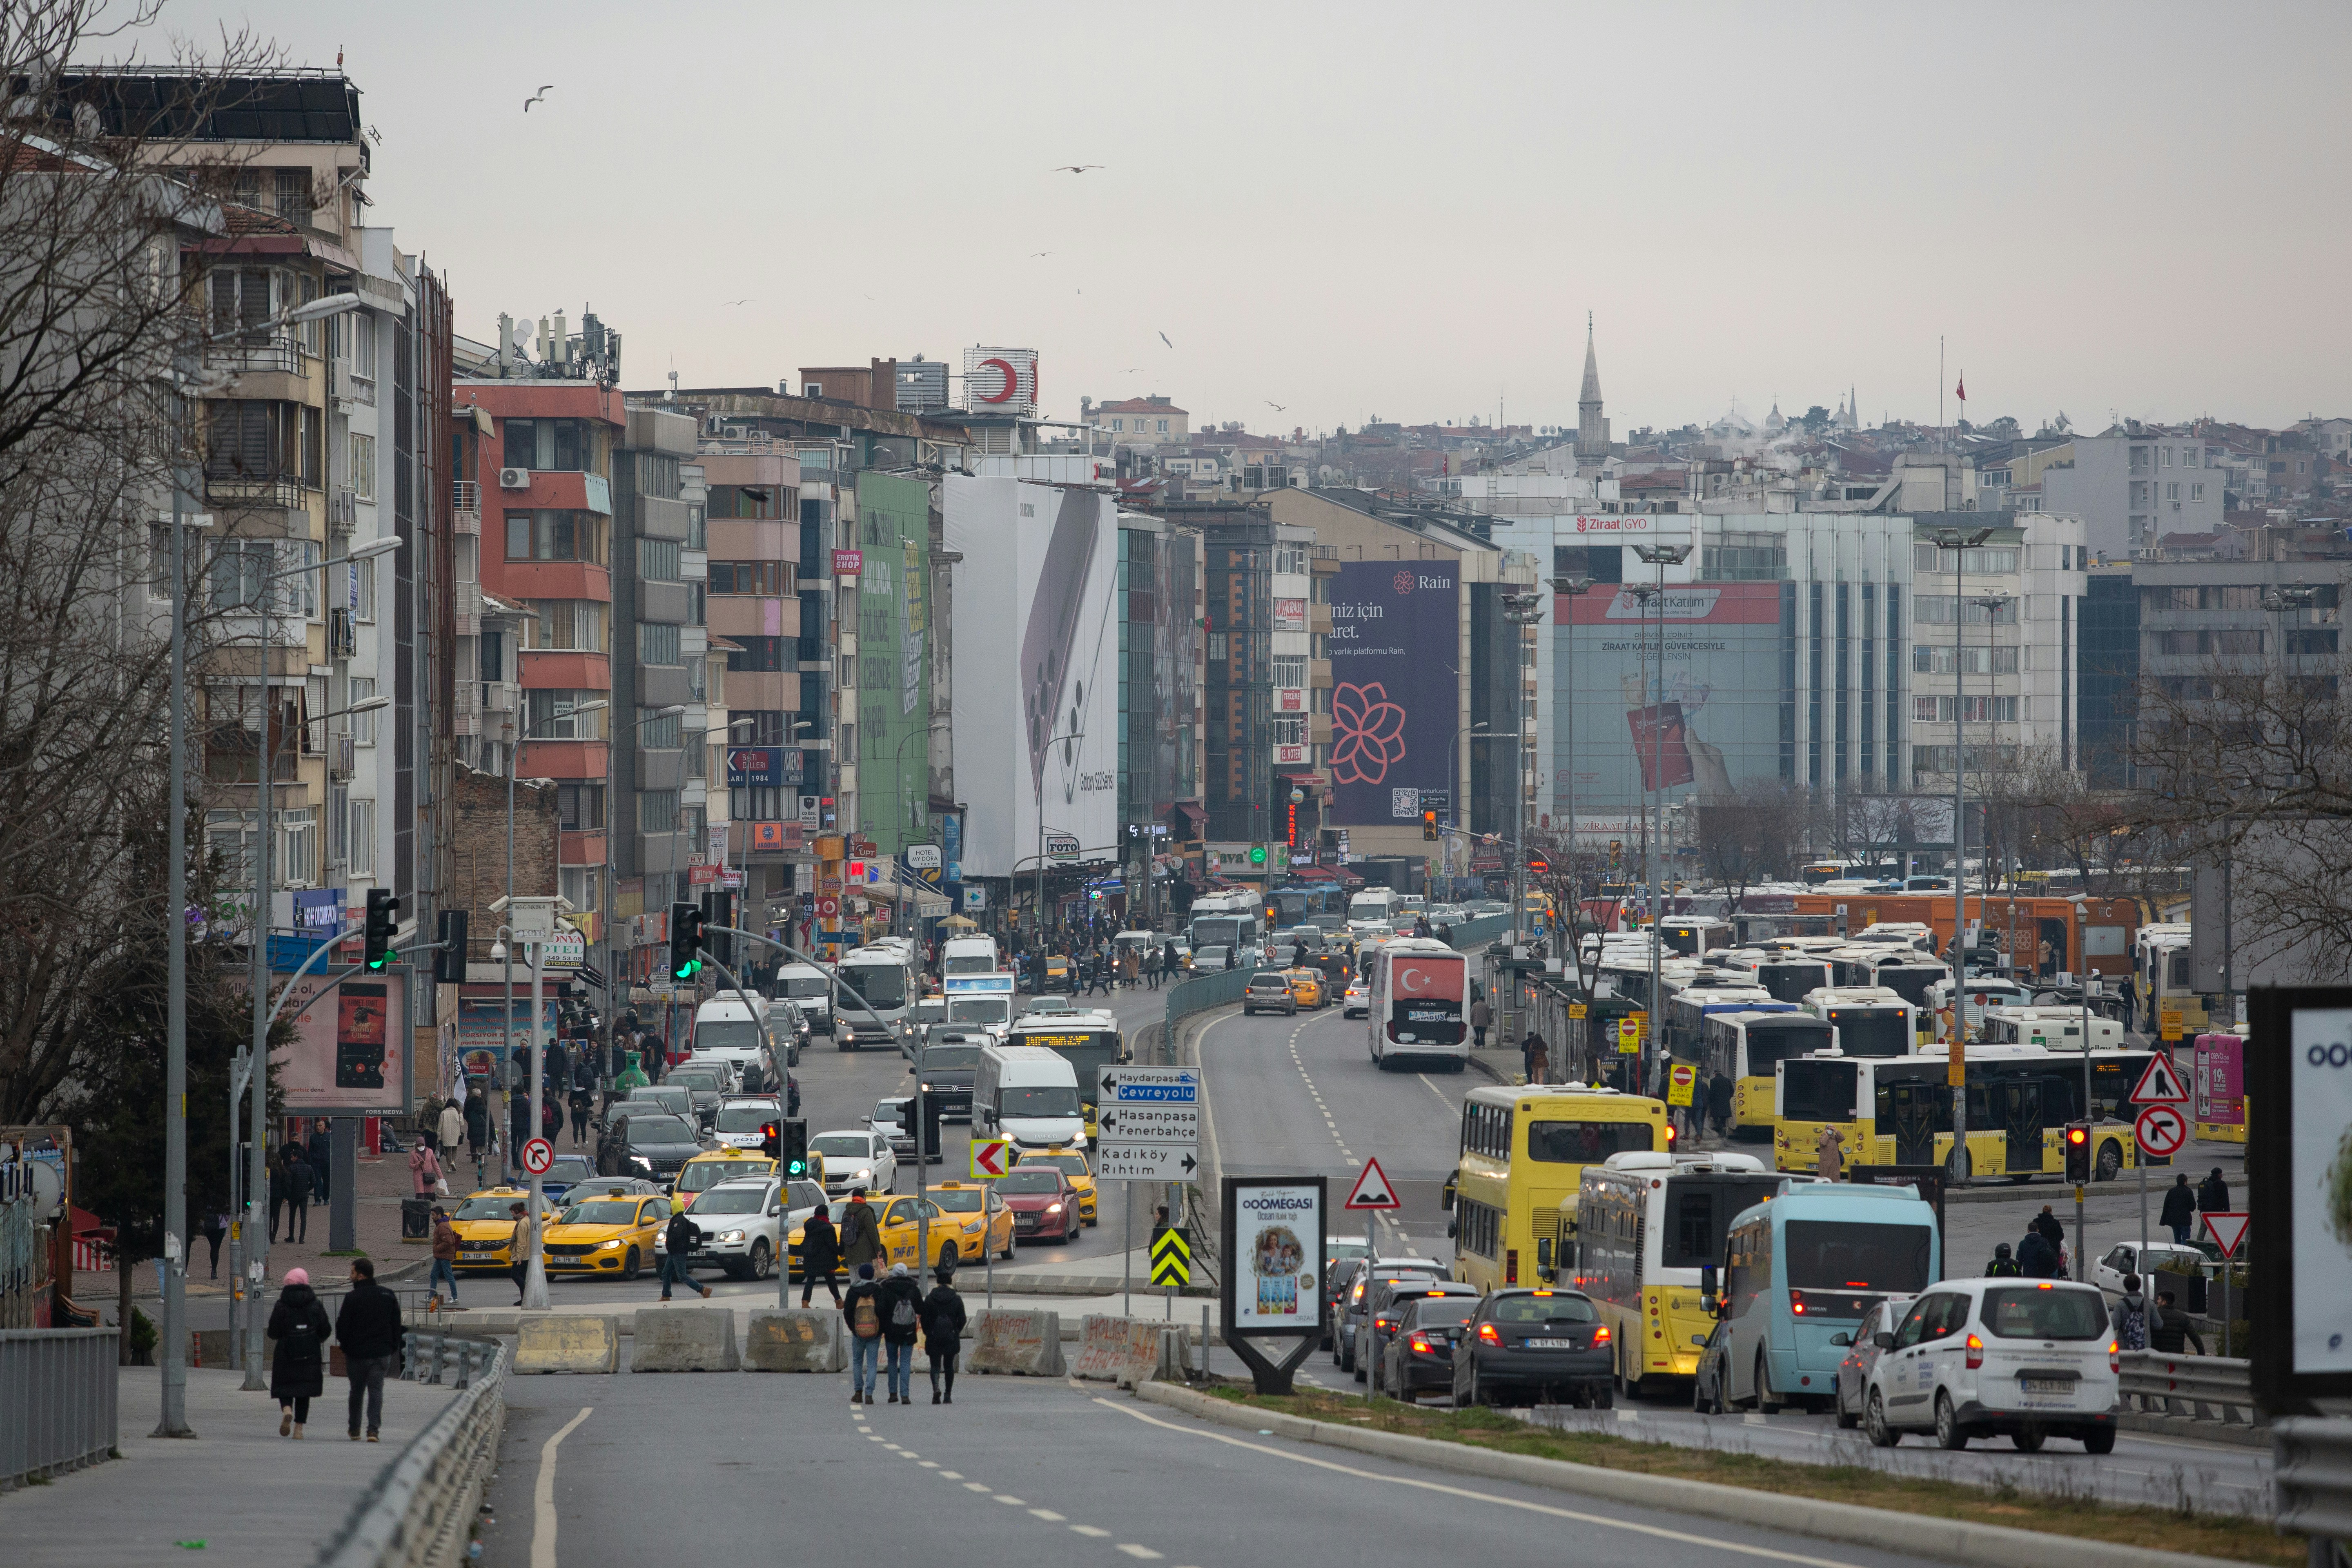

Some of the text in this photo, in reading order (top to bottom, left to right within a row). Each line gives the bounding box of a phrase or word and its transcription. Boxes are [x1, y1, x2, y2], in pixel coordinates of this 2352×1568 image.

[1020, 502, 1034, 518] SAMSUNG
[1590, 518, 1646, 529] Ziraat GYO
[837, 553, 860, 561] EROTİK
[864, 560, 893, 602] AKLINDA,
[1419, 575, 1450, 589] Rain
[1670, 595, 1704, 607] Katılım
[1357, 603, 1383, 621] için
[1334, 646, 1405, 657] varlık platformu Rain,
[1602, 641, 1630, 650] ZİRAAT
[1664, 641, 1725, 650] GÜVENCESİYLE
[1636, 650, 1691, 660] DEĞELENSİN
[1287, 748, 1301, 760] NOTER
[1080, 772, 1094, 796] Galaxy
[1102, 769, 1114, 790] Serisi
[1583, 820, 1622, 830] ZİRAAT
[1049, 844, 1077, 852] FOTO
[1220, 851, 1245, 864] ava
[315, 904, 337, 927] OTOMASYON
[879, 910, 889, 920] E
[2098, 906, 2111, 918] WC
[552, 935, 583, 944] ONYA
[526, 944, 583, 954] HOTEL
[300, 983, 316, 996] ol,
[347, 999, 364, 1007] AHMET
[1120, 1073, 1180, 1084] Haydarpaşa
[1120, 1086, 1194, 1100] Çevreyolu
[1119, 1109, 1196, 1123] Hasanpaşa
[1119, 1125, 1195, 1138] Fenerbahçe
[1102, 1148, 1167, 1162] Kadıköy
[1102, 1164, 1154, 1174] Rıhtım
[1257, 1211, 1274, 1221] Ocean
[1275, 1211, 1287, 1220] Balık
[894, 1246, 915, 1258] THF 87
